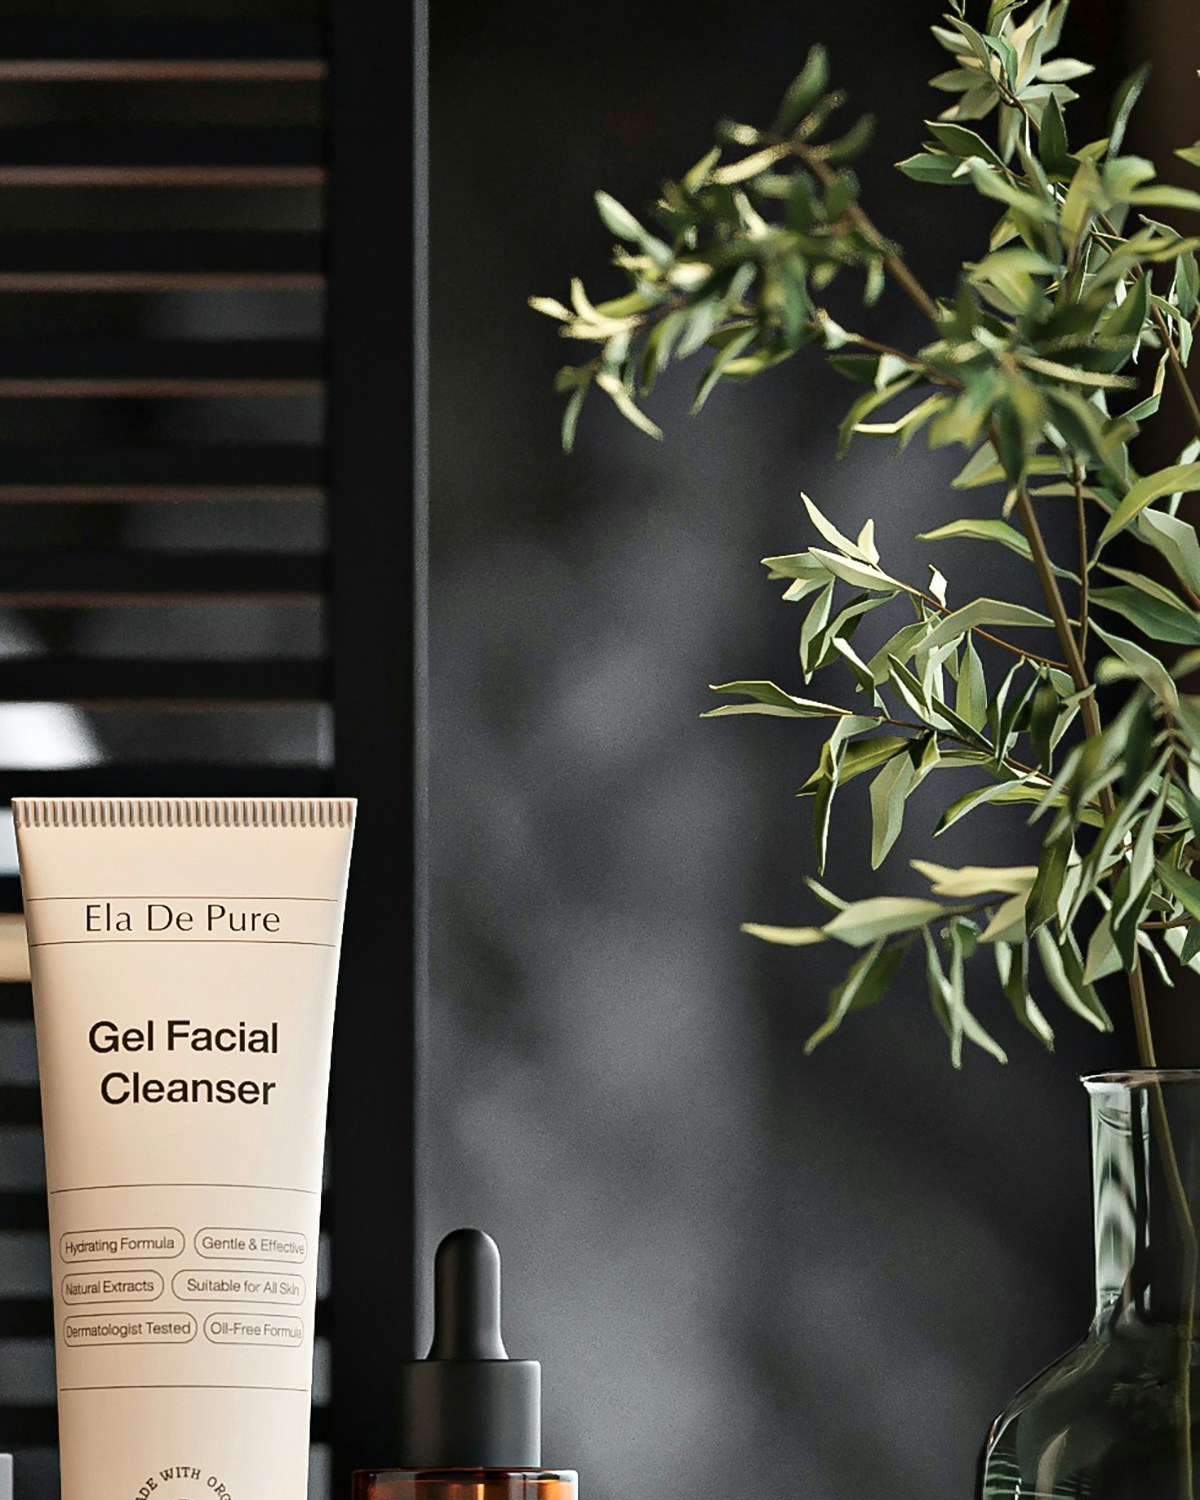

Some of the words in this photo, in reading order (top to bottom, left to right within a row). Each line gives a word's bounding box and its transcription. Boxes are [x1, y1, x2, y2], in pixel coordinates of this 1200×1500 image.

[85, 902, 132, 933] Ela
[147, 904, 194, 933] De
[206, 904, 281, 933] Pure
[88, 1020, 154, 1054] Gel
[167, 1020, 279, 1054] Facial
[100, 1071, 277, 1105] Cleanser
[65, 1238, 118, 1256] Hydrating
[120, 1236, 175, 1251] Formula
[201, 1237, 246, 1251] Gentle
[248, 1238, 258, 1251] &
[260, 1238, 305, 1255] Effective
[65, 1281, 101, 1296] Natural
[103, 1280, 155, 1294] Extracts
[186, 1278, 241, 1293] Suitable
[244, 1279, 260, 1293] for
[262, 1280, 278, 1294] All
[279, 1281, 300, 1296] Skin
[65, 1322, 143, 1339] Dermatologist
[146, 1321, 191, 1335] Tested
[210, 1321, 262, 1336] Oil-Free
[263, 1323, 303, 1339] Formula
[159, 1466, 202, 1482] WITH
